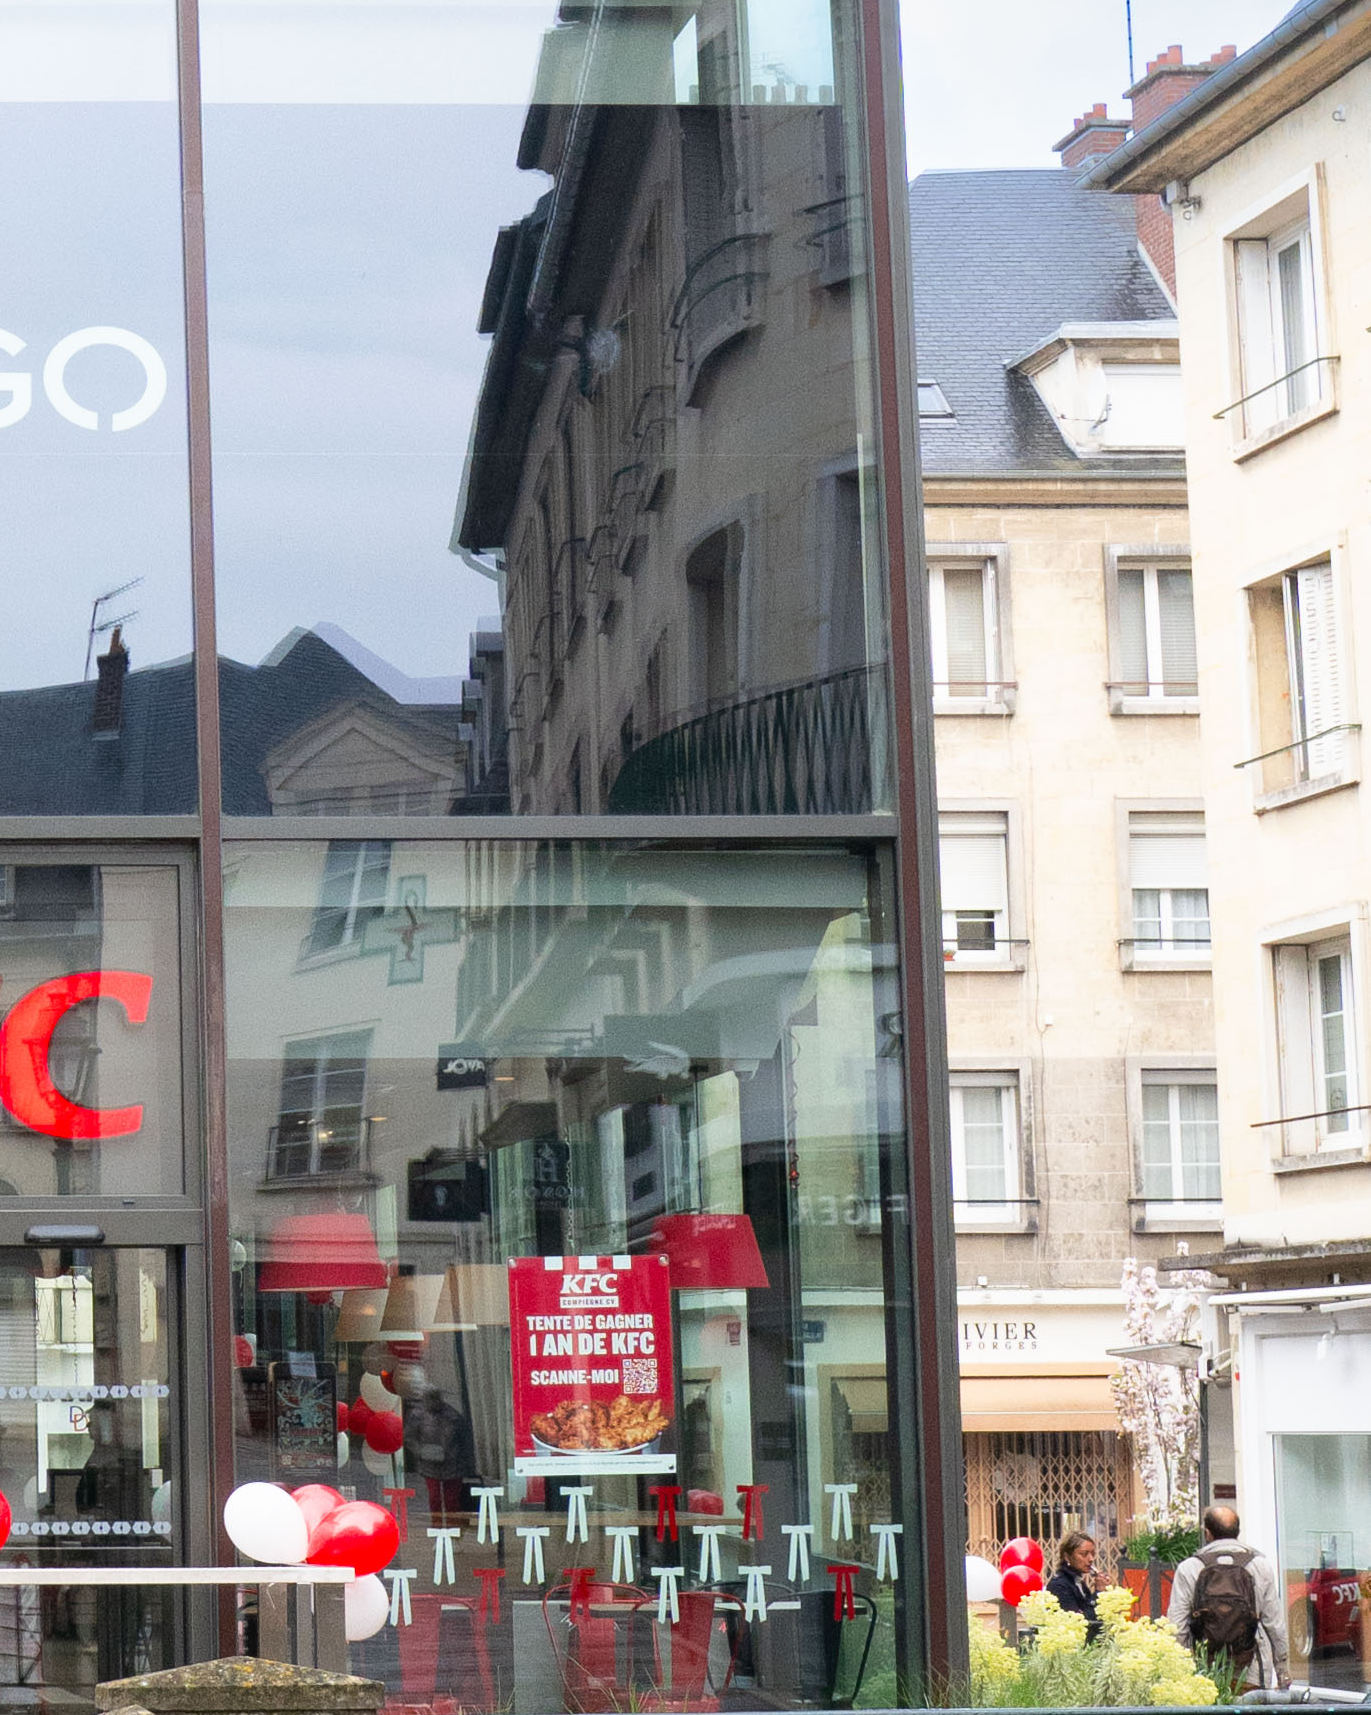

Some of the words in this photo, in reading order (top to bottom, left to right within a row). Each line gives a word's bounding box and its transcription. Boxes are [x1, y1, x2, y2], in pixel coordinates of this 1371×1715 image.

[561, 1273, 618, 1294] KFC
[527, 1315, 572, 1330] TENTE
[574, 1315, 593, 1329] DE
[596, 1314, 654, 1329] GAGNER
[963, 1322, 1037, 1340] IVIER
[543, 1333, 574, 1357] AN
[579, 1333, 608, 1356] DE
[612, 1331, 656, 1355] KFC
[965, 1341, 1037, 1350] FORGES
[530, 1368, 620, 1386] SCANNE-MOI
